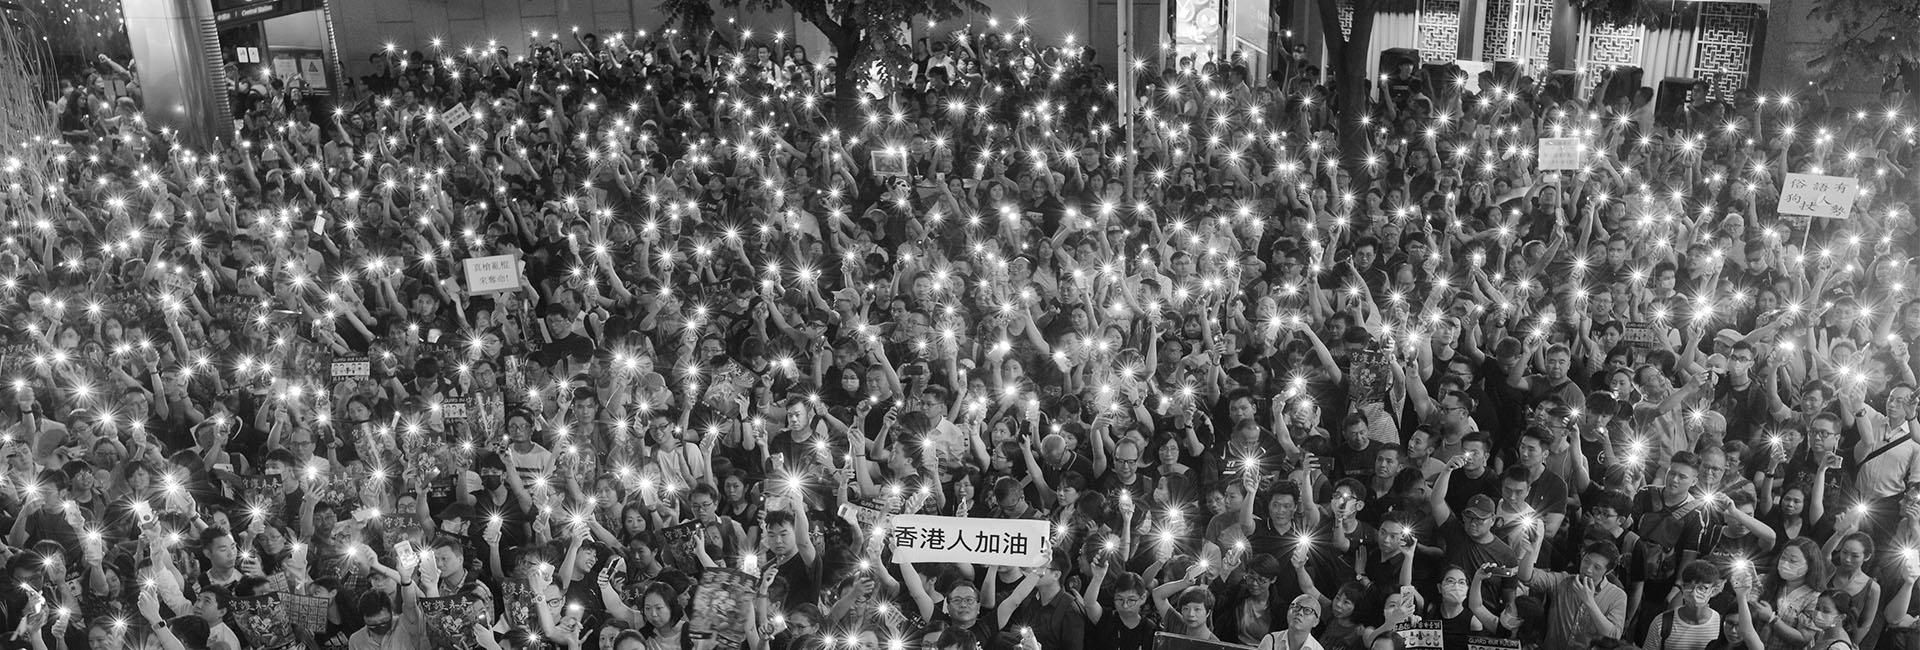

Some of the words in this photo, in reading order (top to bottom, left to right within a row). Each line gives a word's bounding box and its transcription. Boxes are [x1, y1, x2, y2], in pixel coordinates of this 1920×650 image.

[894, 526, 1046, 555] 香港人加油！
